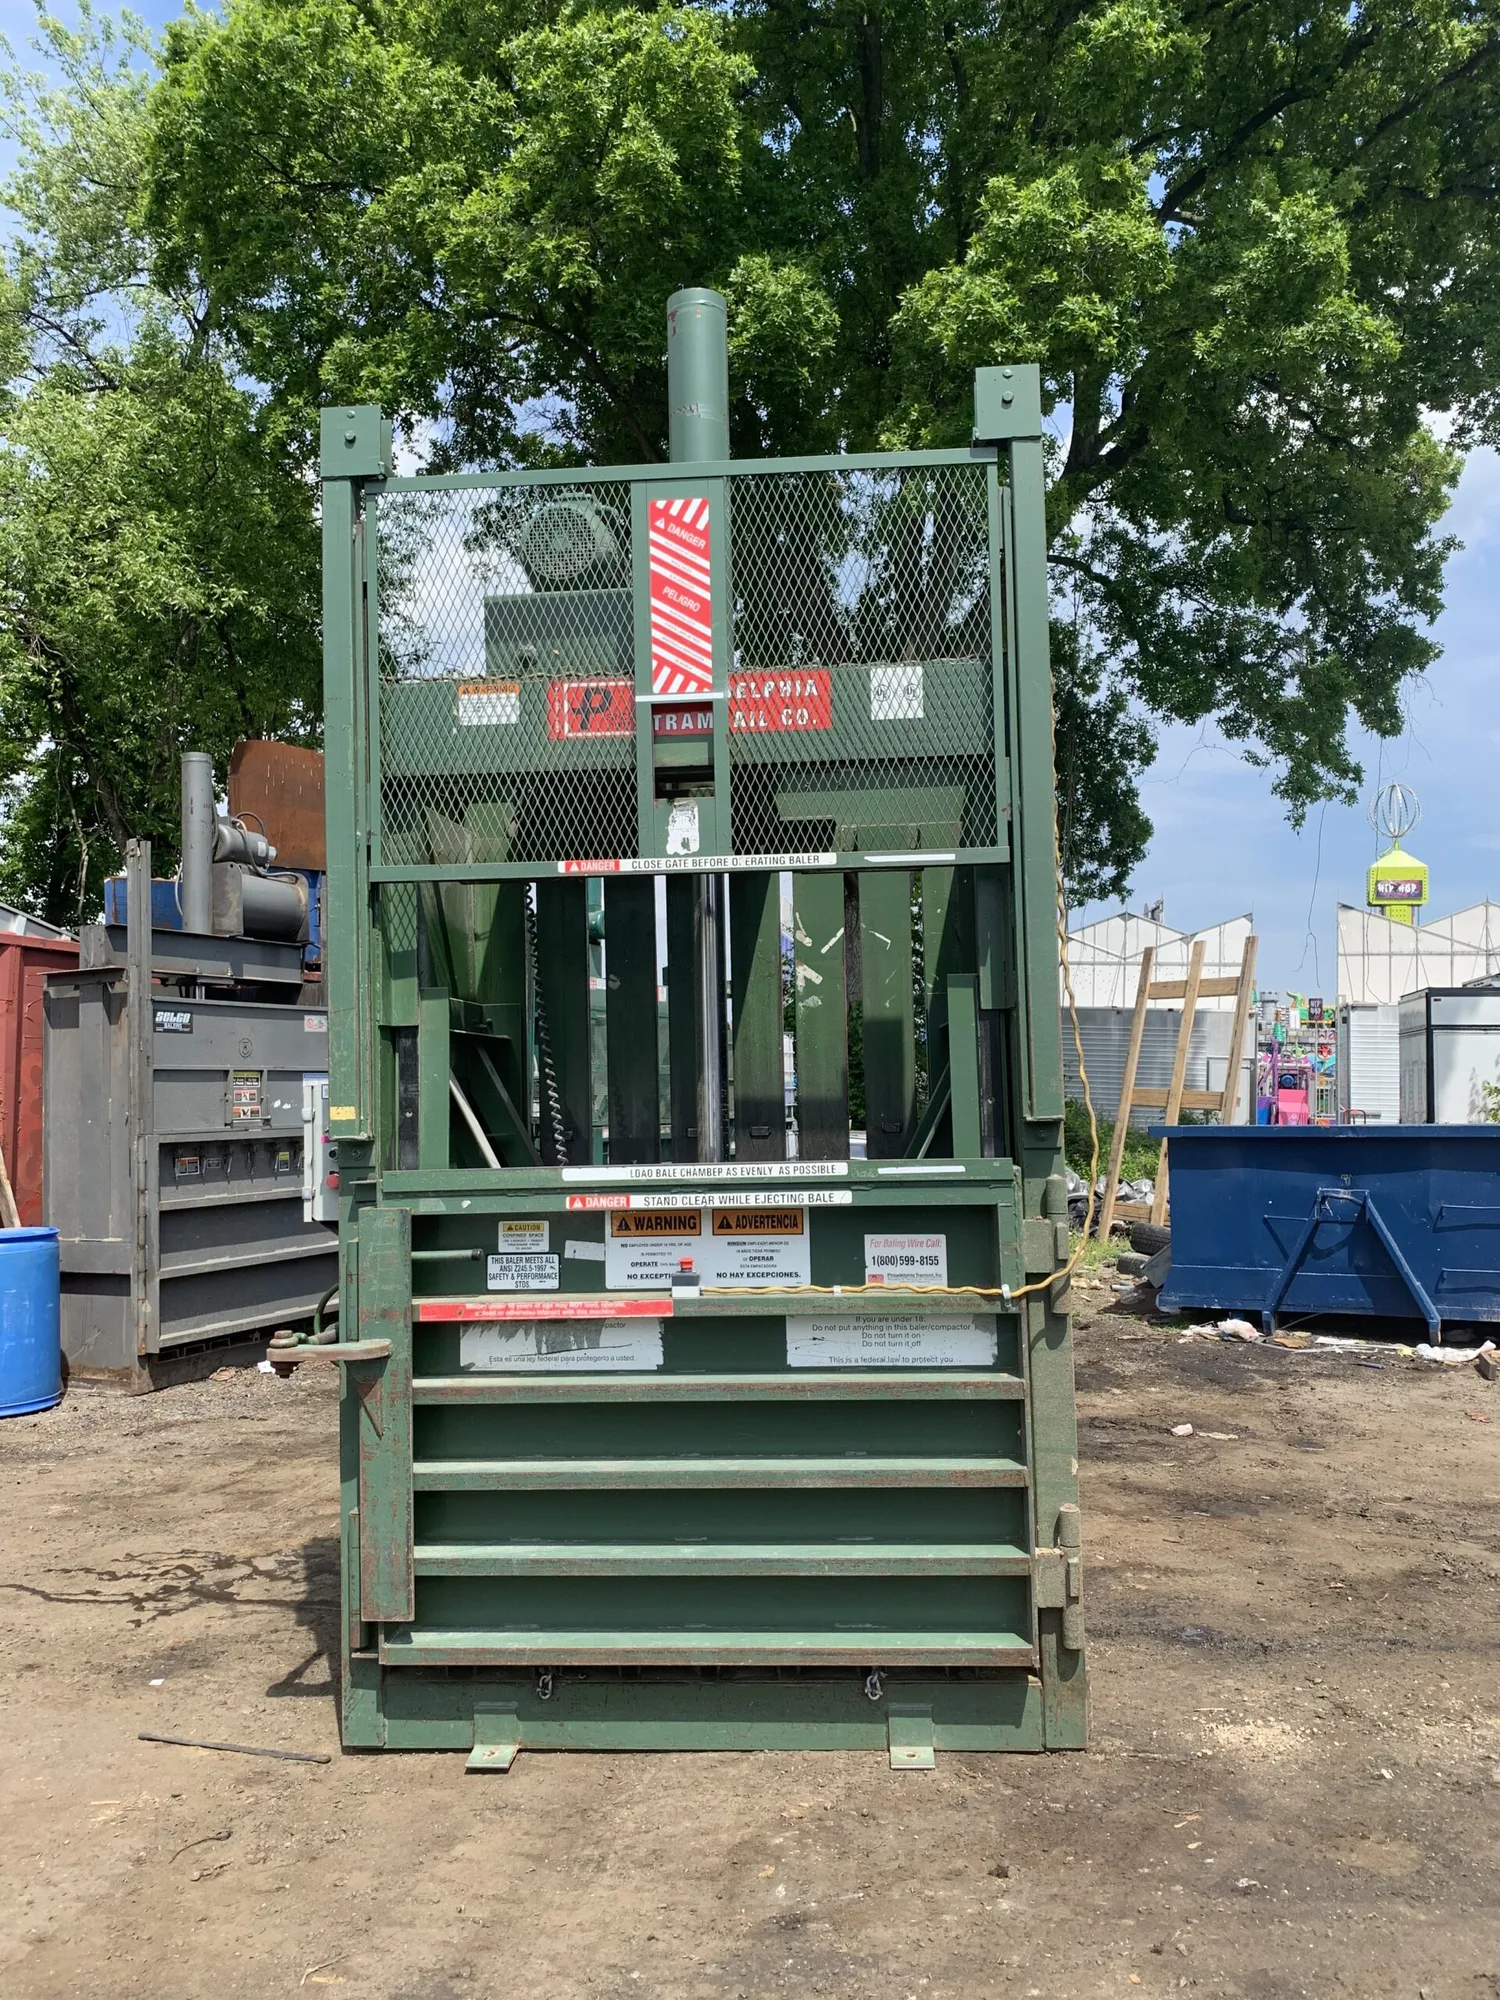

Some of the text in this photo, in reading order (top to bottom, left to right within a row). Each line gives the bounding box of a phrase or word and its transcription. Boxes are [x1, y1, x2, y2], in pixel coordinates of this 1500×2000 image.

[667, 523, 706, 550] DANGER
[662, 586, 700, 612] PELIGRO
[728, 680, 818, 699] ELPHIA
[782, 708, 817, 726] CO.
[581, 861, 615, 871] DANGER
[632, 859, 663, 869] CLOSE
[665, 859, 688, 868] GATE
[692, 858, 728, 868] BEFORE
[789, 855, 820, 865] BALER
[1377, 883, 1417, 896] HIP HOP
[630, 1168, 653, 1178] LOAD
[656, 1167, 677, 1178] BALE
[680, 1167, 723, 1177] CHAMBER
[726, 1166, 738, 1176] AS
[740, 1166, 773, 1176] EVENLY
[778, 1166, 790, 1175] AS
[586, 1193, 835, 1208] DANGER STAND CLEAR WHILE EJECTING BALE
[634, 1215, 696, 1230] WARNING
[736, 1214, 798, 1229] ADVERTENCIA
[870, 1239, 942, 1249] For Baling Wire Call:
[525, 1256, 543, 1264] MEETS
[517, 1272, 557, 1280] PERFORMANCE
[839, 1324, 850, 1332] put
[852, 1324, 883, 1332] anything
[910, 1323, 970, 1332] baler/compactor
[577, 1355, 609, 1363] protegerlo
[912, 1356, 938, 1364] protect
